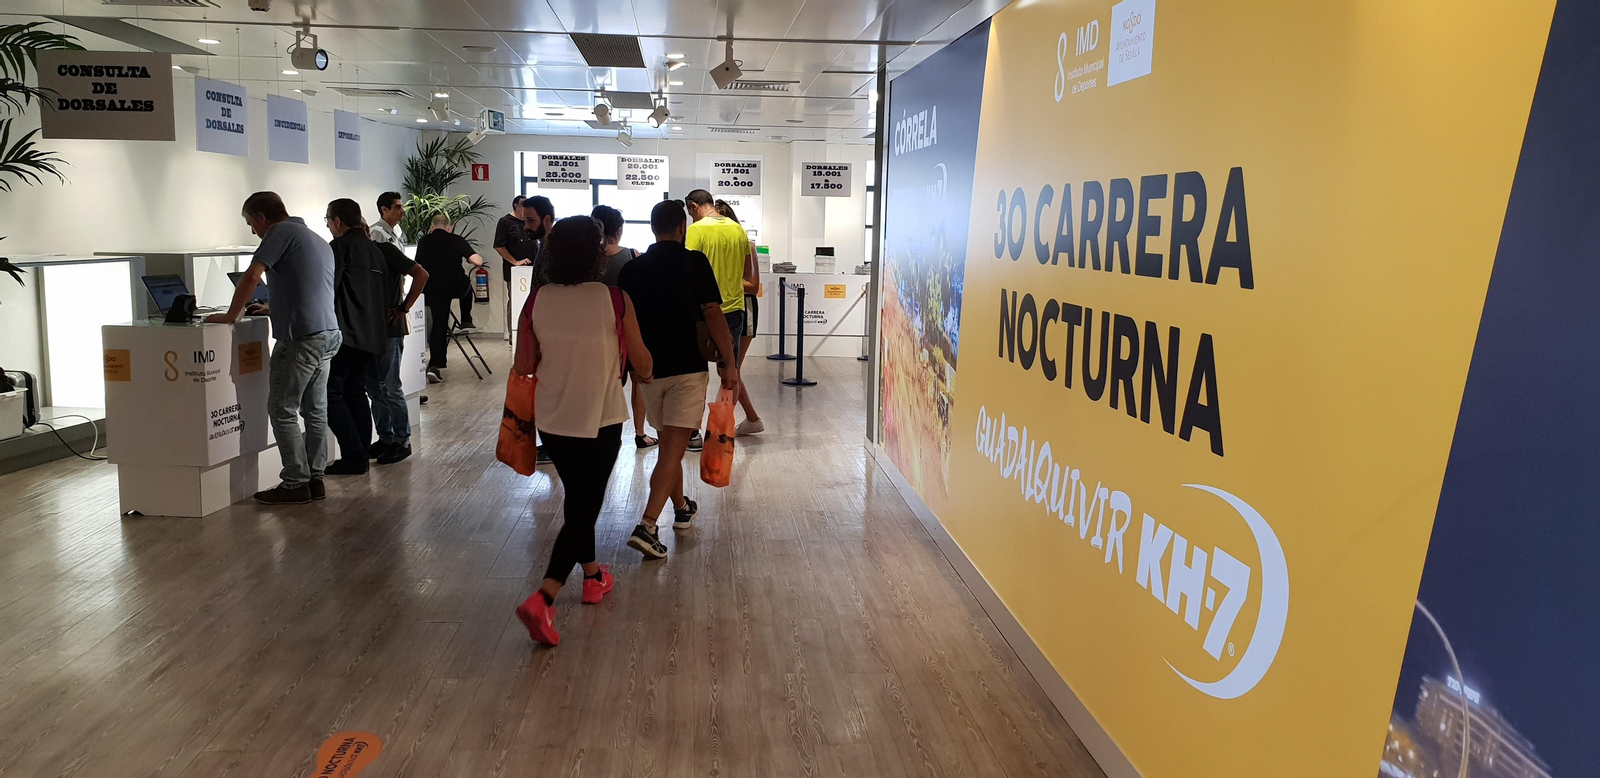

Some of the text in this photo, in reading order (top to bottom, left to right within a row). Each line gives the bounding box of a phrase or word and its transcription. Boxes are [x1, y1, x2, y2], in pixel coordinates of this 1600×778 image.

[1075, 20, 1100, 56] IMD
[1114, 31, 1147, 51] AYUNTAMIENTO
[57, 64, 151, 78] CONSULTA
[91, 82, 118, 94] DE
[57, 98, 154, 112] DORSALES
[205, 90, 243, 107] CONSULTA
[220, 107, 232, 118] DE
[205, 118, 245, 134] DORSALES
[274, 119, 306, 132] INCIDENCIAS
[894, 105, 937, 156] CÓRRELA
[547, 160, 579, 168] 22.501
[545, 171, 582, 179] 25.000
[625, 173, 660, 181] 22.500
[993, 166, 1254, 290] 30 CARRERA
[193, 349, 216, 364] IMD
[998, 288, 1224, 457] NOCTURNA
[211, 403, 242, 419] 30 CARRERA
[213, 413, 241, 428] NOCTURNA
[975, 404, 1251, 661] GUADALQUIVIR KH-7
[320, 737, 357, 775] NOCTURNA
